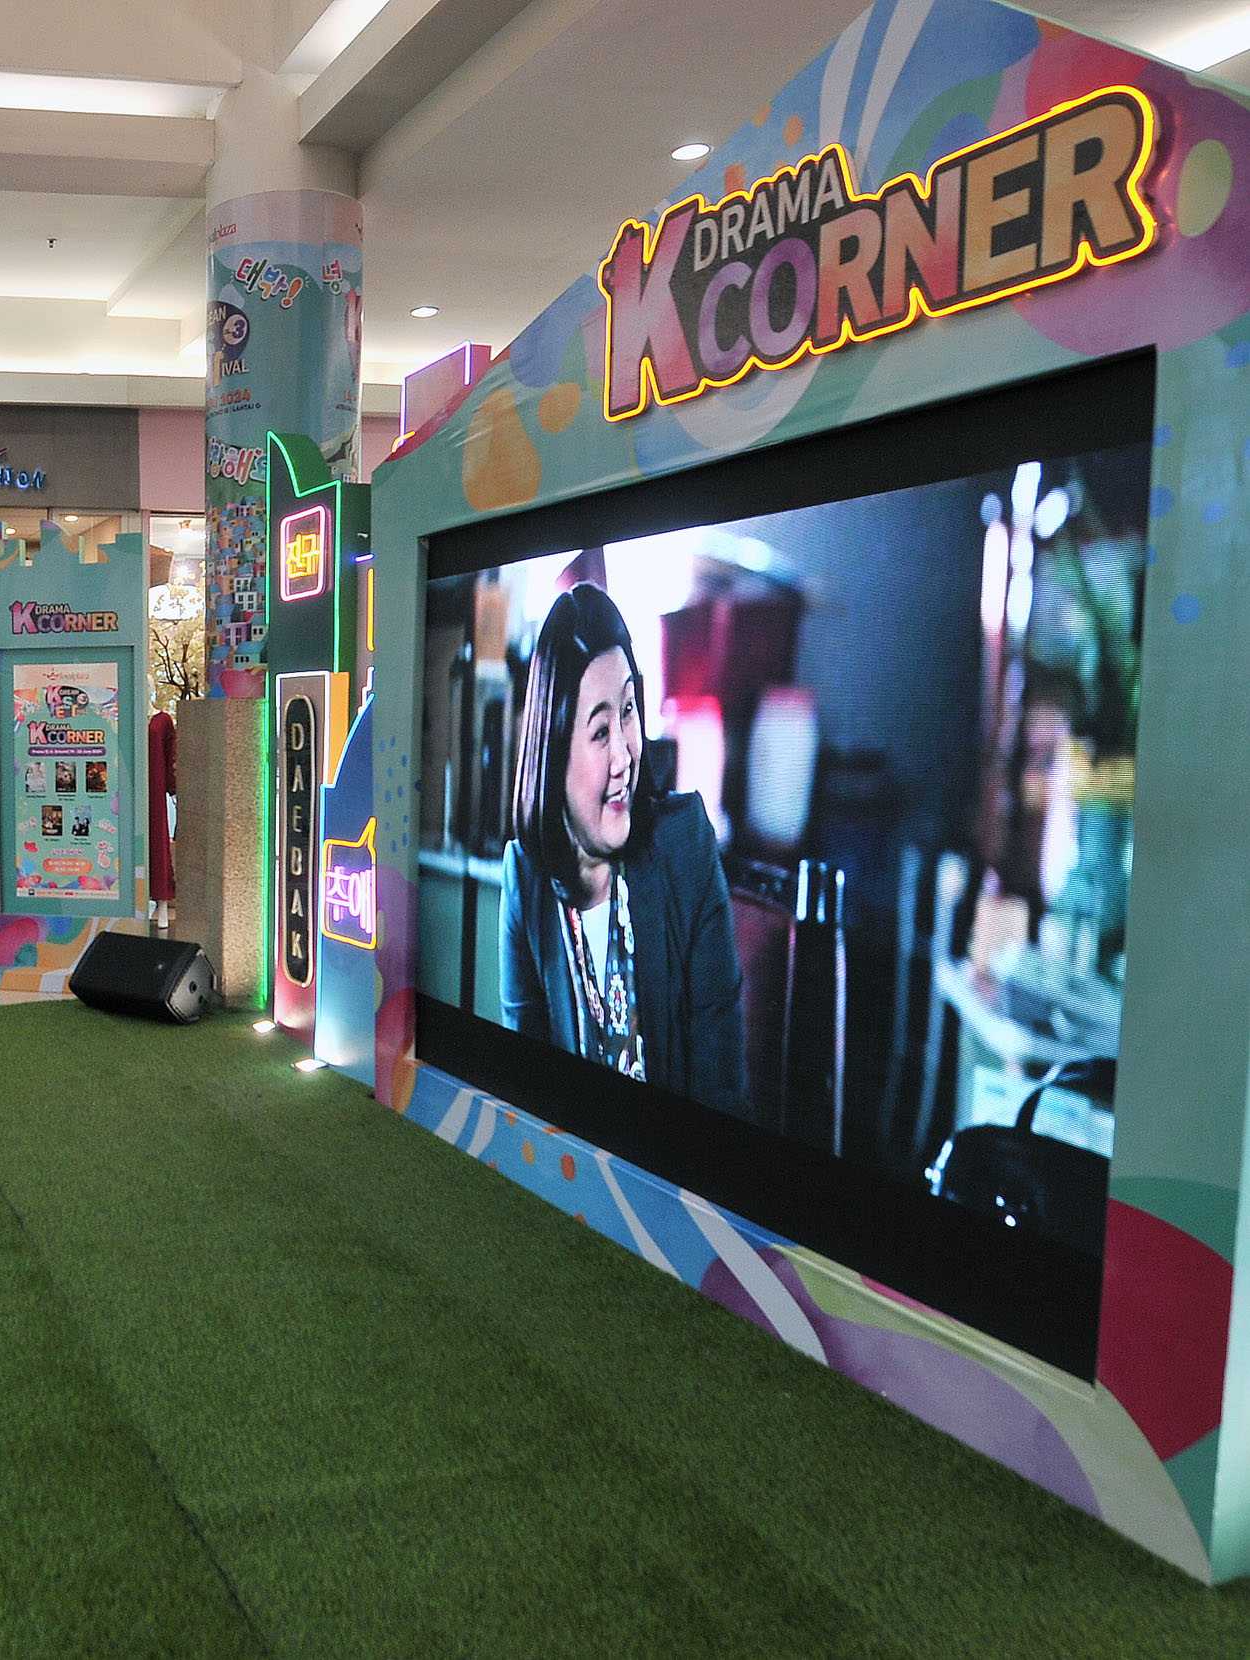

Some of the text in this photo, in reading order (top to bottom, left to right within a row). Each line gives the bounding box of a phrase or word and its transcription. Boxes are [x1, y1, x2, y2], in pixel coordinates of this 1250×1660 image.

[693, 154, 846, 273] DRAMA
[696, 102, 1137, 376] CORNER
[236, 257, 304, 308] 대박!
[232, 319, 246, 339] 3
[35, 604, 71, 615] DRAMA
[37, 611, 118, 633] CORNER
[47, 730, 105, 744] CORNER
[290, 722, 305, 960] DAEBAK
